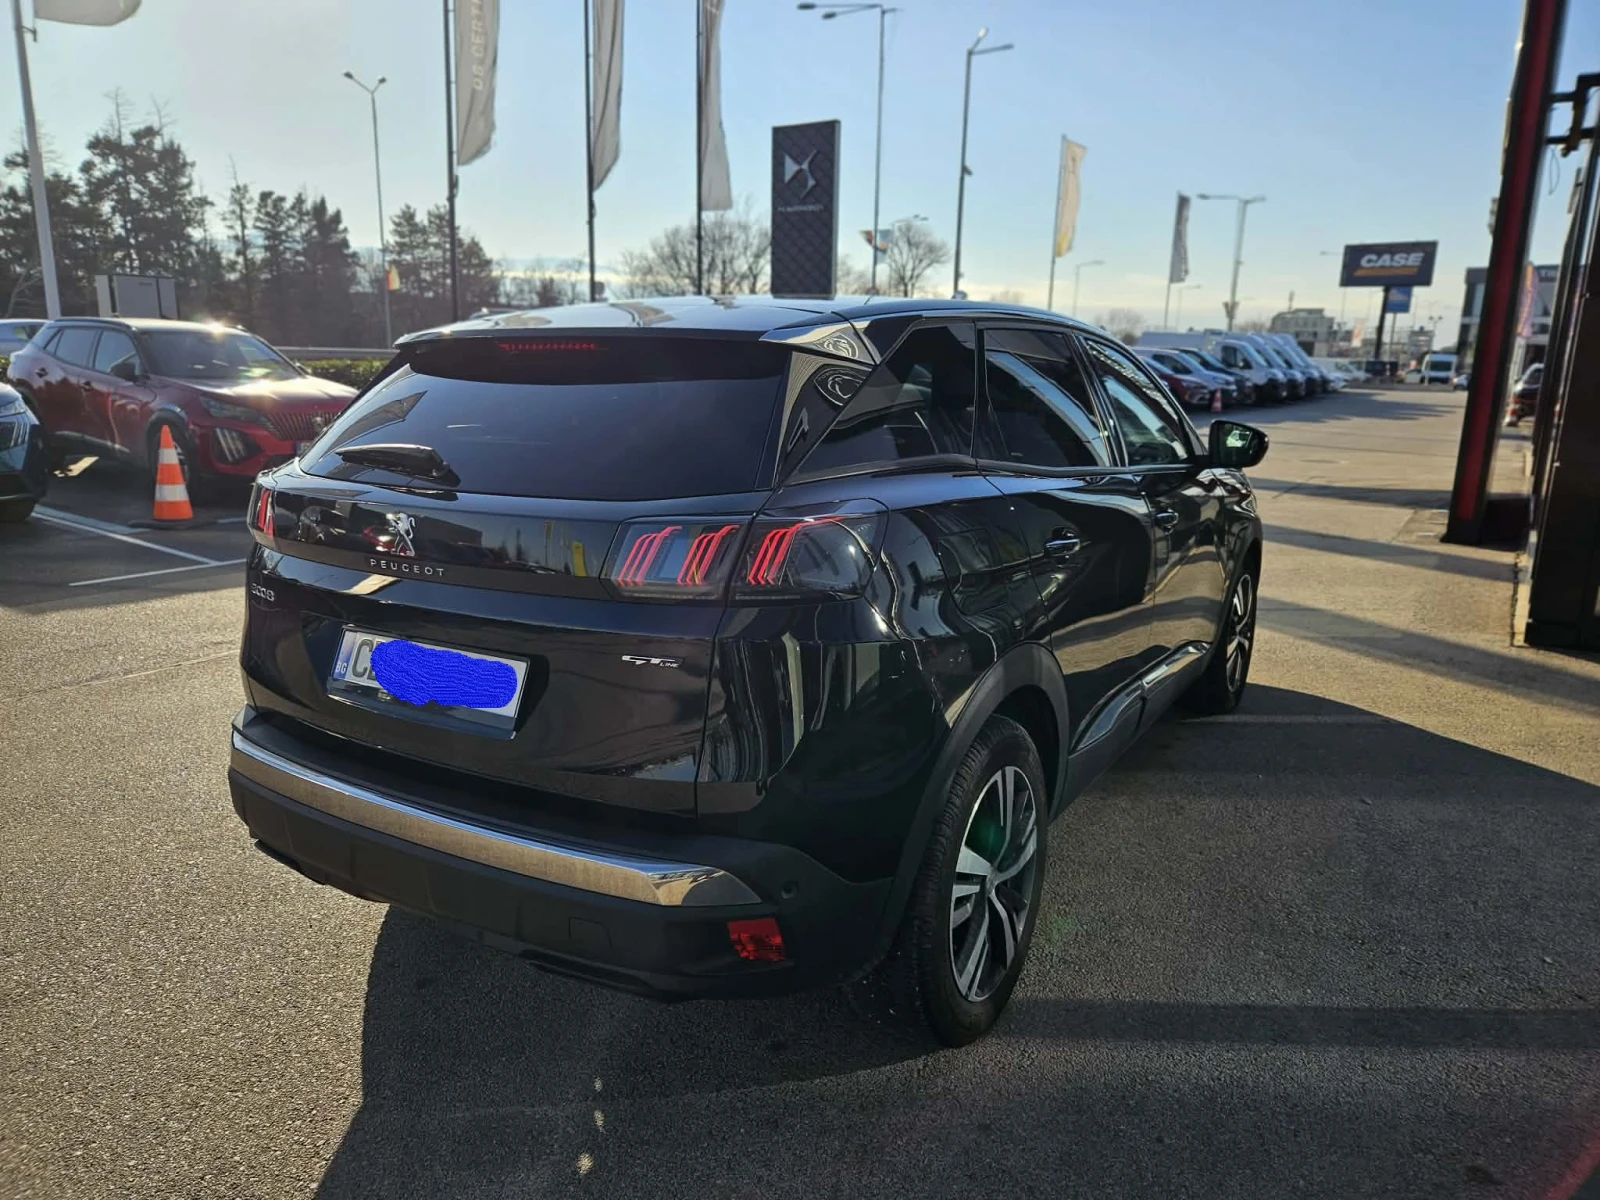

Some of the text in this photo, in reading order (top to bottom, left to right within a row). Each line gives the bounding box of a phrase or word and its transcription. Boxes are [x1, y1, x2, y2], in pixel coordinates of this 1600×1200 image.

[1360, 252, 1425, 268] CASE
[369, 558, 445, 577] PEUGEOT
[334, 661, 348, 675] BG
